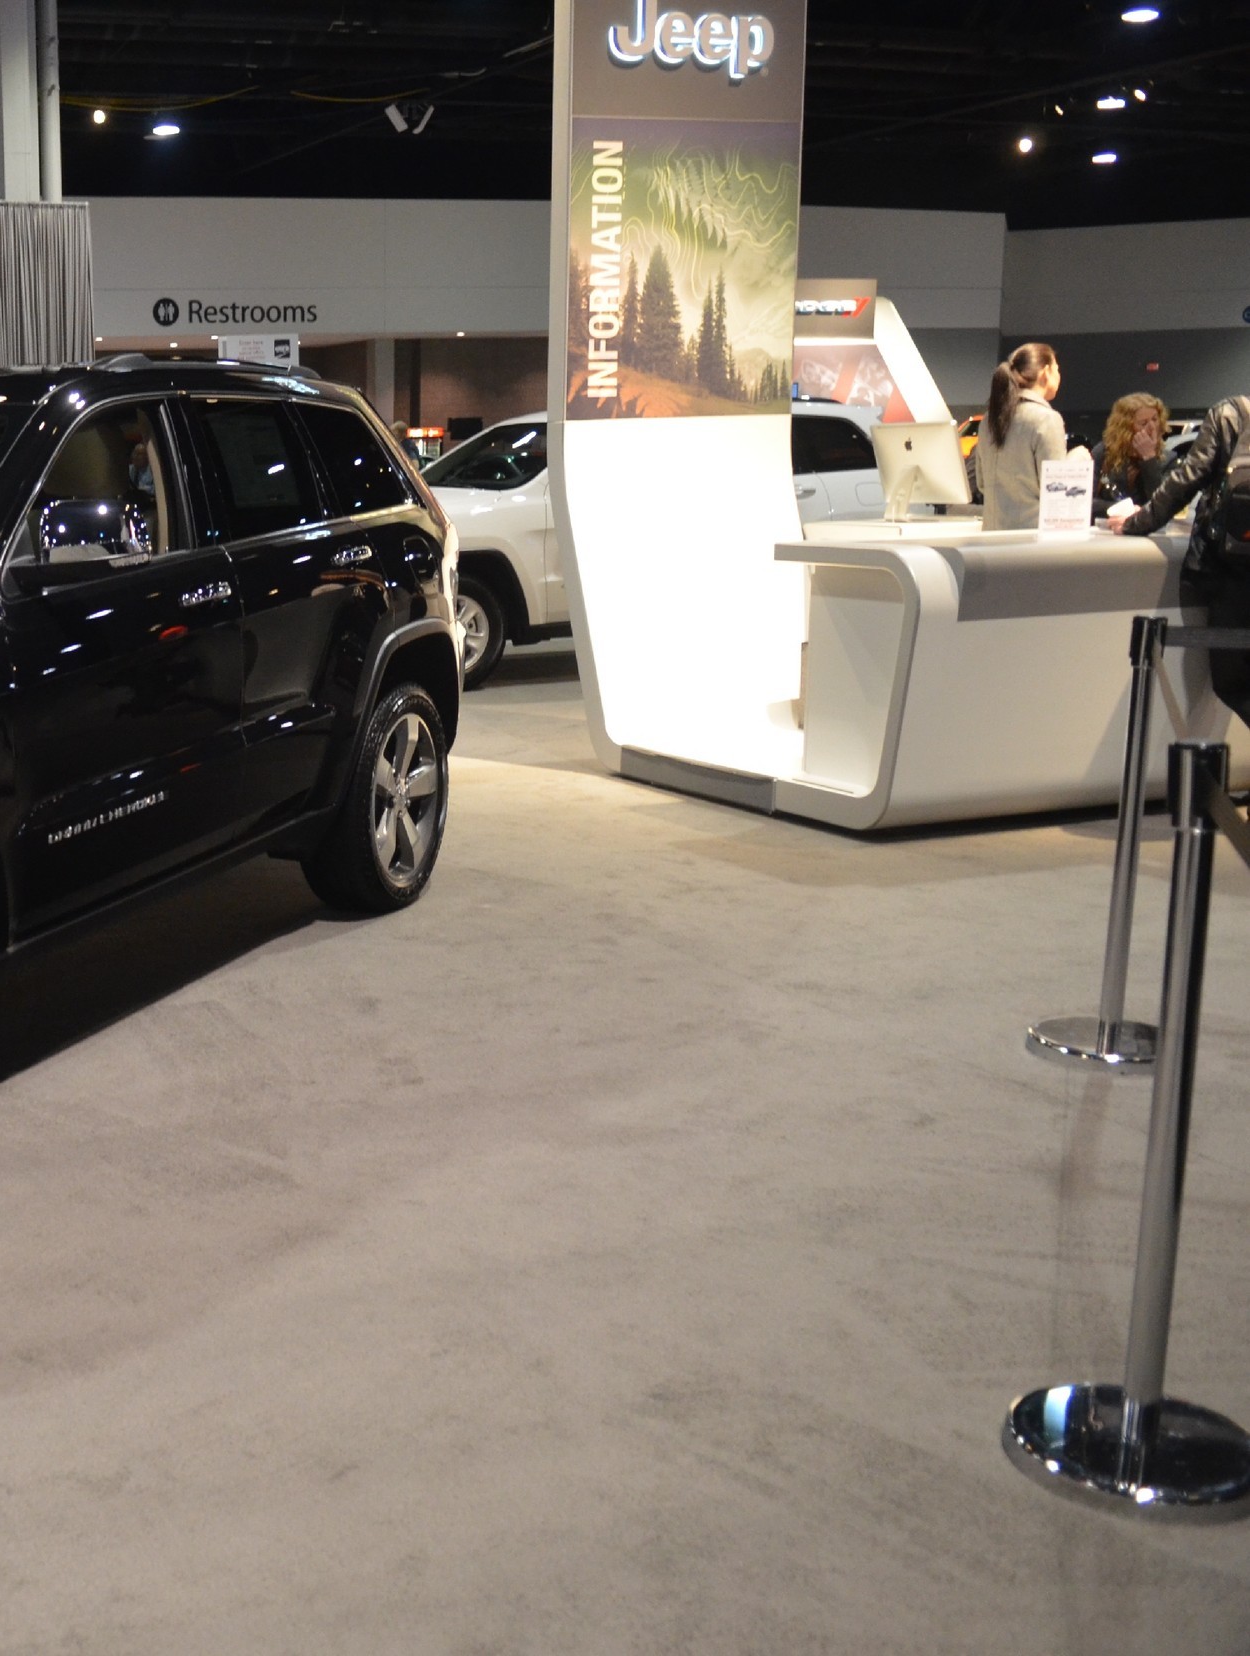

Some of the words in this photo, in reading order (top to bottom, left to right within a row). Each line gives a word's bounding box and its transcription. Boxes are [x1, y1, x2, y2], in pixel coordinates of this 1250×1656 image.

[609, 0, 775, 79] Jeep
[587, 140, 624, 398] INFORMATION
[187, 299, 318, 324] Restrooms
